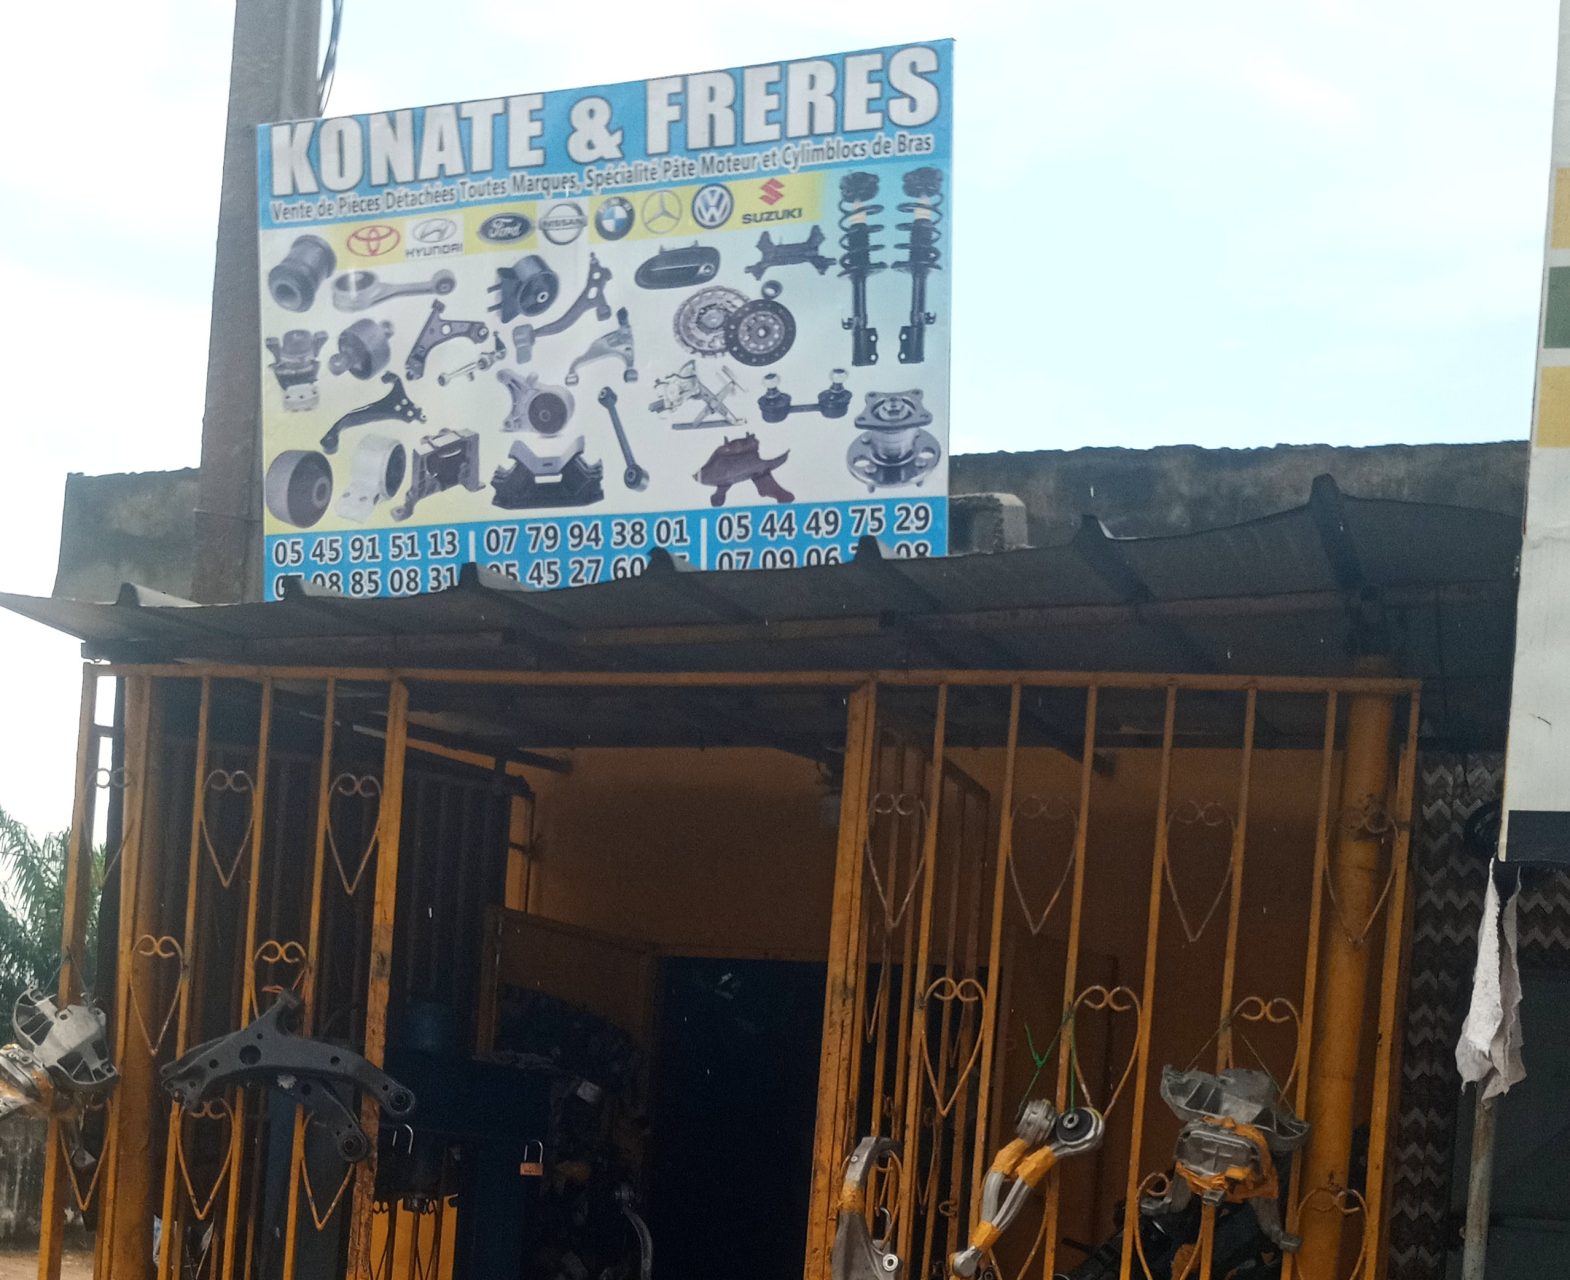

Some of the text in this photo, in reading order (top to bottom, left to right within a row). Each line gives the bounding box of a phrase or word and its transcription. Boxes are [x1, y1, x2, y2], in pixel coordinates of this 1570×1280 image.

[271, 46, 939, 196] KONATE & FRERES
[272, 202, 313, 221] Vente
[317, 201, 334, 216] de
[459, 180, 507, 199] Toutes
[512, 173, 581, 198] Marques,
[586, 161, 659, 194] Spécialité
[663, 159, 696, 180] Pâte
[701, 155, 757, 174] Moteur
[763, 152, 777, 167] et
[783, 137, 867, 171] Cylimblocs
[873, 136, 891, 156] de
[898, 134, 932, 153] Bras
[488, 217, 522, 238] Ford
[542, 216, 584, 229] NISSAN
[742, 207, 803, 225] SUZUKI
[485, 519, 688, 553] 07 79 94 38 01
[718, 505, 930, 540] 05 44 49 75 29
[274, 531, 457, 566] 05 45 91 51 13
[351, 570, 380, 595] 85
[390, 568, 419, 594] 08
[429, 566, 457, 591] 31
[528, 560, 559, 586] 45
[571, 558, 602, 585] 27
[613, 556, 645, 579] 60
